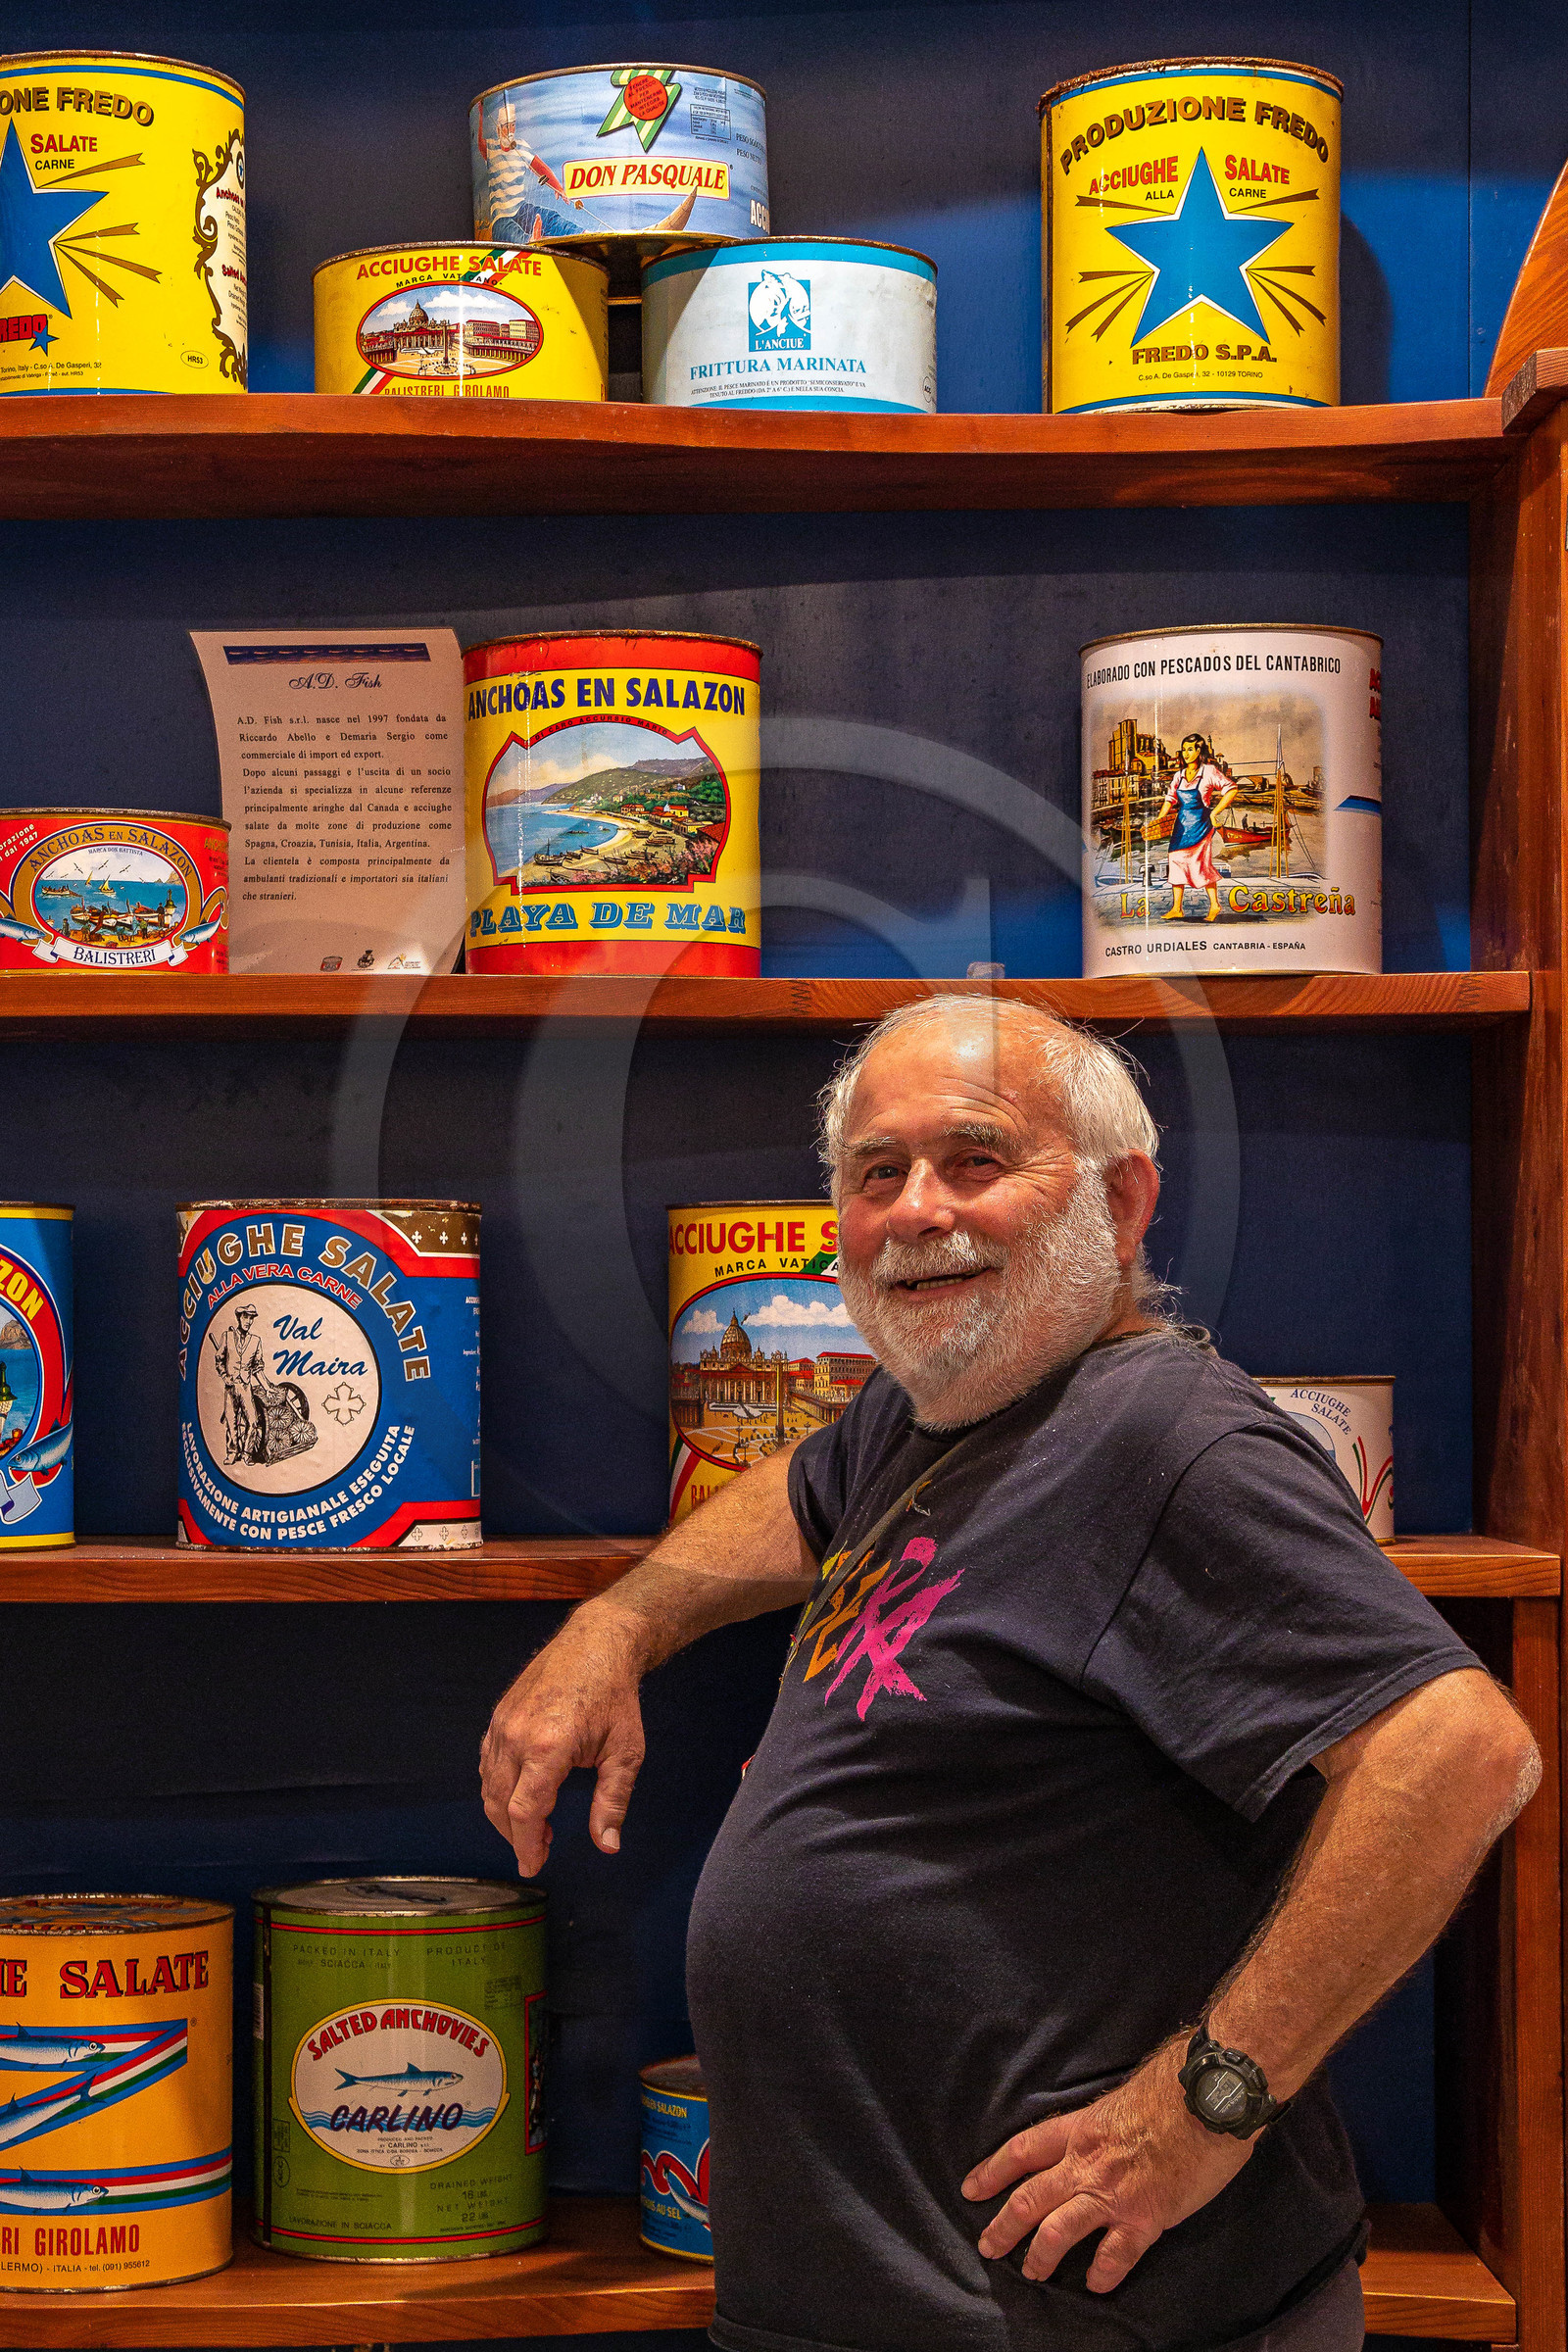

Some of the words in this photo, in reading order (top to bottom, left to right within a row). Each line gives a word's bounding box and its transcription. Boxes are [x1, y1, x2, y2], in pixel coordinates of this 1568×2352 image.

[57, 86, 154, 127] FREDO
[30, 133, 97, 153] SALATE
[1059, 96, 1246, 176] PRODUZIONE
[1254, 101, 1329, 164] FREDO
[35, 159, 74, 171] CARNE
[1089, 156, 1178, 196] ACCIUGHE
[1225, 154, 1290, 185] SALATE
[568, 168, 617, 190] DON
[621, 165, 726, 190] PASQUALE
[1145, 189, 1174, 200] ALLA
[1229, 188, 1267, 199] CARNE
[357, 255, 460, 280] ACCIUGHE
[468, 256, 541, 276] SALATE
[396, 275, 433, 288] MARCA
[756, 338, 804, 351] L'ANCIUE
[1133, 344, 1208, 365] FREDO
[1215, 344, 1277, 363] S.P.A.
[187, 355, 203, 365] HR53
[690, 359, 770, 381] FRITTURA
[777, 358, 866, 373] MARINATA
[345, 672, 382, 688] Fish
[1087, 664, 1130, 689] ELABORADO
[1134, 664, 1155, 678] CON
[1160, 656, 1231, 674] PESCADOS
[1236, 655, 1261, 670] DEL
[1266, 655, 1342, 674] CANTABRICO
[468, 678, 564, 720] ANCHOAS
[577, 678, 614, 707] EN
[626, 678, 745, 715] SALAZON
[239, 733, 276, 742] Riccardo
[387, 732, 415, 742] Sergio
[549, 720, 572, 733] CARO
[637, 720, 667, 734] MARIO
[241, 750, 295, 760] commerciale
[310, 751, 337, 760] import
[354, 751, 384, 760] export.
[243, 768, 266, 777] Dopo
[271, 768, 297, 777] alcuni
[304, 768, 340, 778] passaggi
[358, 767, 389, 776] l'uscita
[244, 786, 282, 795] l'azienda
[305, 786, 352, 796] specializza
[375, 785, 403, 794] alcune
[412, 785, 452, 794] referenze
[245, 804, 308, 813] principalmente
[313, 804, 344, 813] aringhe
[350, 804, 362, 812] dal
[414, 803, 452, 812] acciughe
[372, 821, 420, 831] produzione
[5, 845, 18, 857] dal
[20, 831, 37, 847] 1947
[27, 827, 104, 872] ANCHOAS
[127, 828, 192, 877] SALAZON
[245, 840, 277, 850] Spagna,
[281, 839, 316, 849] Croazia,
[319, 839, 353, 849] Tunisia,
[357, 840, 381, 849] Italia,
[385, 839, 430, 850] Argentina.
[264, 857, 299, 865] clientela
[319, 858, 360, 866] composta
[368, 857, 431, 866] principalmente
[244, 874, 284, 883] ambulanti
[289, 874, 337, 883] tradizionali
[351, 874, 397, 884] importatori
[418, 874, 448, 883] italiani
[260, 892, 296, 901] stranieri.
[1120, 893, 1152, 919] La
[1228, 886, 1355, 915] Castreña
[469, 904, 578, 938] PLAYA
[589, 903, 655, 929] DE
[664, 904, 746, 934] MAR
[74, 947, 156, 965] BALISTRERI
[1105, 944, 1142, 957] CASTRO
[1147, 941, 1207, 954] URDIALES
[1272, 941, 1306, 950] ESPAÑA
[714, 1258, 767, 1277] MARCA
[207, 1275, 243, 1309] ALLA
[243, 1263, 294, 1280] VERA
[298, 1267, 364, 1310] CARNE
[179, 1222, 306, 1382] ACCIUGHE
[318, 1235, 431, 1382] SALATE
[272, 1314, 322, 1341] Val
[272, 1348, 368, 1377] Maira
[1290, 1389, 1351, 1417] ACCIUGHE
[1311, 1403, 1351, 1436] SALATE
[186, 1422, 239, 1514] LAVORAZIONE
[241, 1494, 349, 1524] ARTIGIANALE
[351, 1425, 402, 1495] ESEGUITA
[240, 1523, 272, 1541] CON
[277, 1519, 327, 1542] PESCE
[330, 1484, 383, 1529] FRESCO
[384, 1425, 416, 1485] LOCALE
[60, 1950, 209, 2000] SALATE
[307, 2011, 378, 2061] SALTED
[380, 2008, 491, 2059] ANCHOVIES
[330, 2102, 464, 2133] CARLINO
[35, 2225, 139, 2256] GIROLAMO
[103, 2262, 122, 2273] (091)
[123, 2260, 150, 2270] 955612
